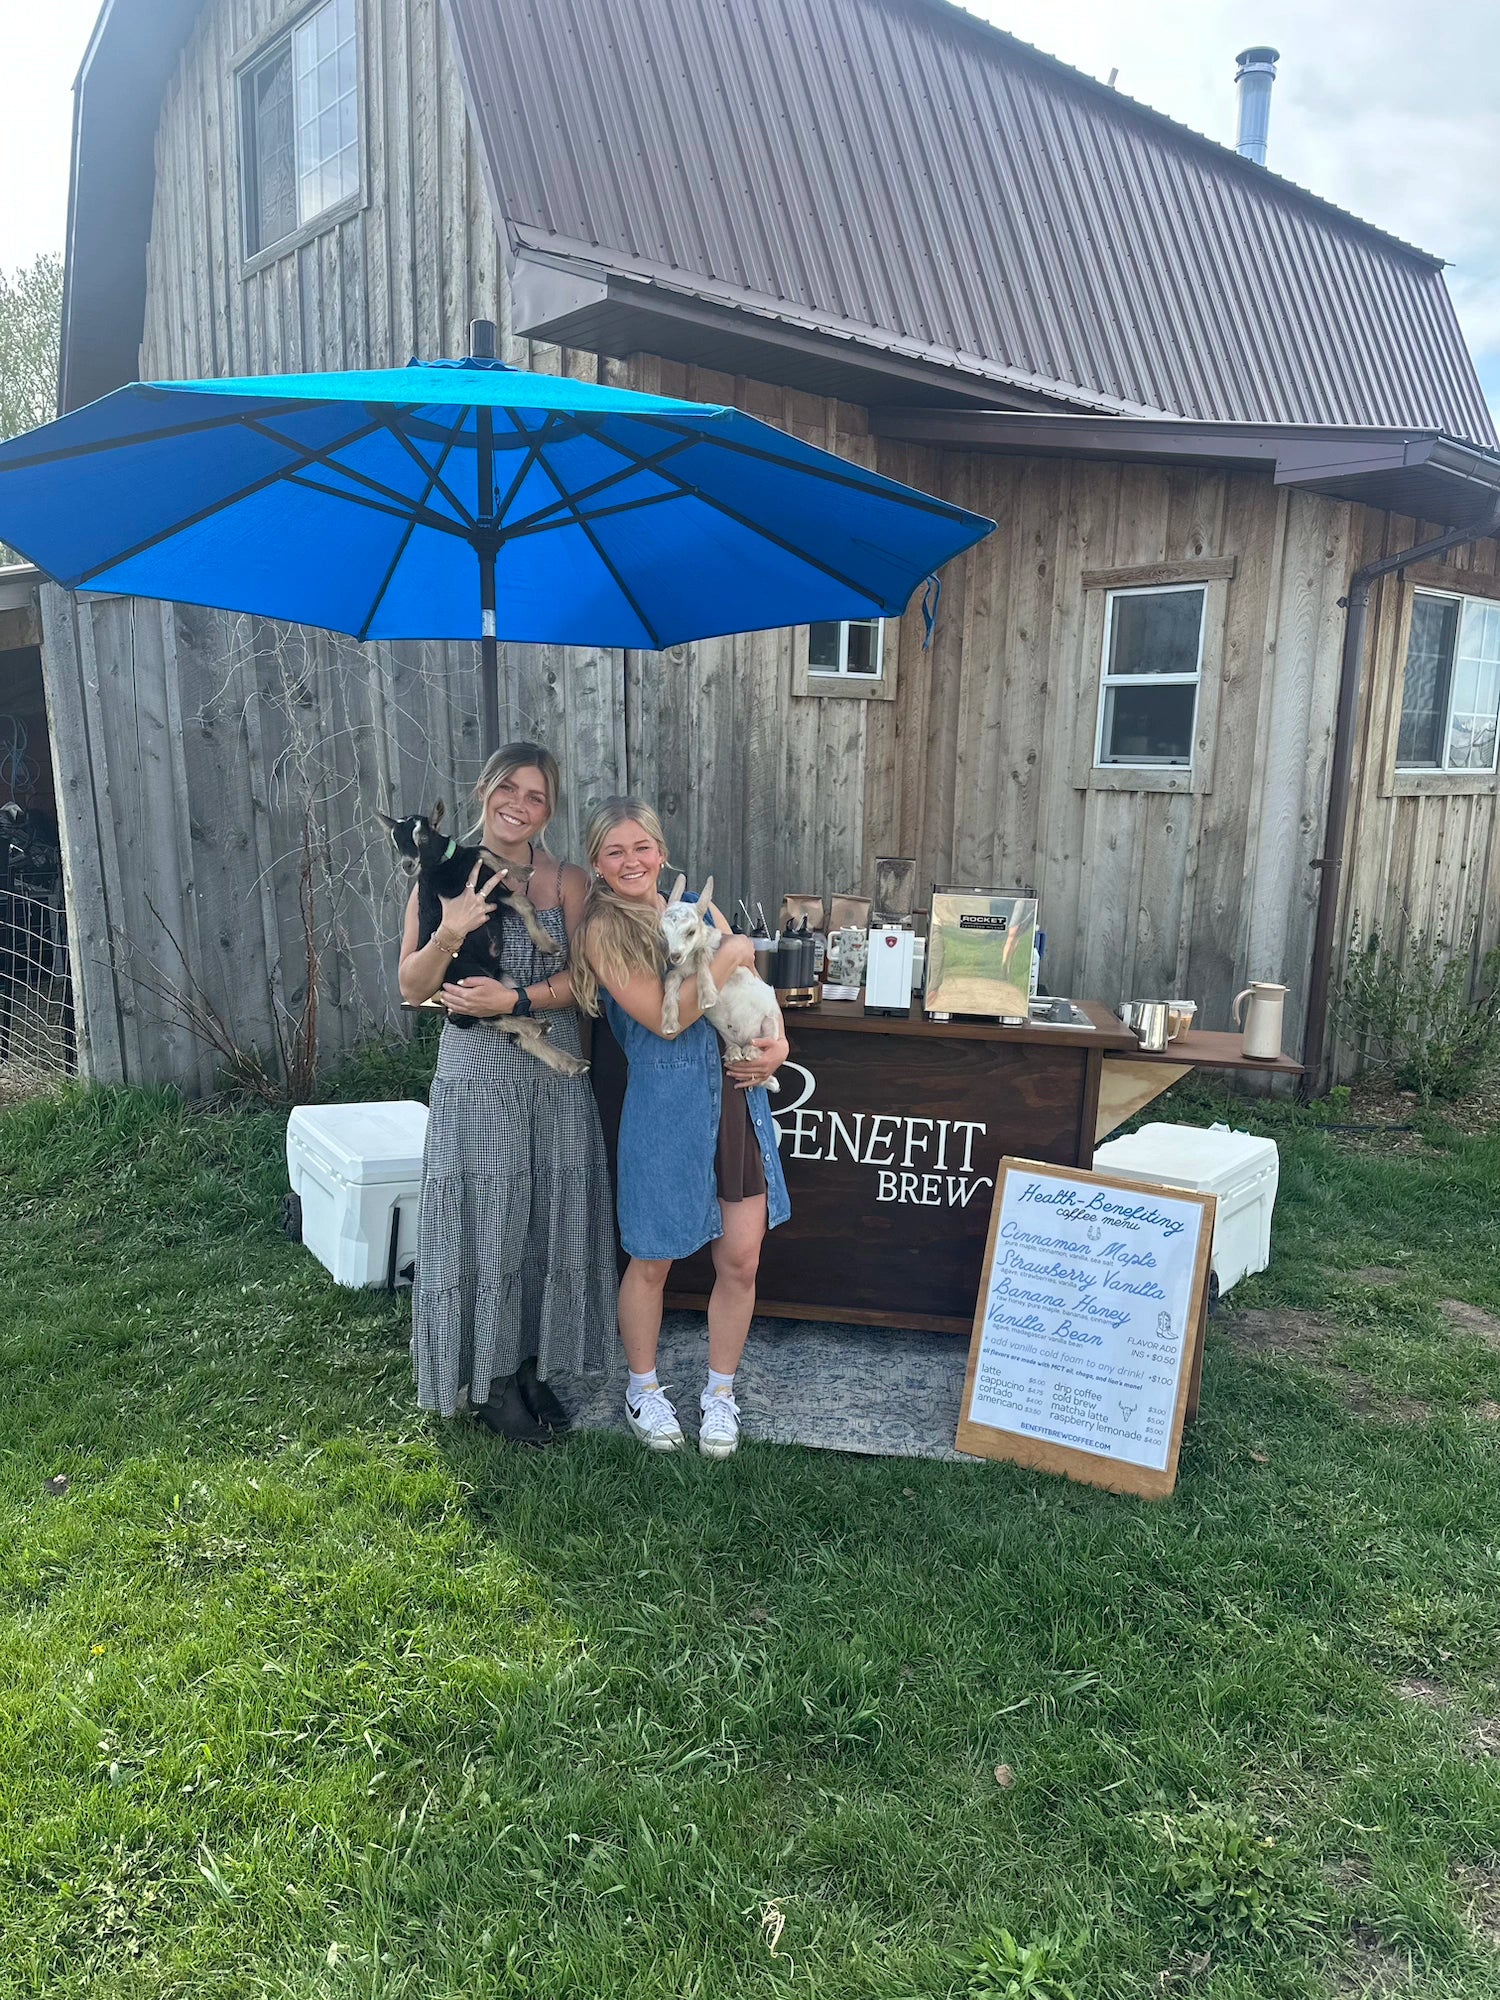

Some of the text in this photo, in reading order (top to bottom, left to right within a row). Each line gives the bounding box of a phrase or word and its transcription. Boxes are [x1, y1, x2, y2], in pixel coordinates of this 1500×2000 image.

[962, 916, 1004, 924] ROCKET
[876, 1170, 993, 1208] BREW
[1018, 1183, 1185, 1237] Health-Benefiting
[1056, 1207, 1141, 1231] coffee menu
[1000, 1221, 1157, 1268] Cinnamon Maple
[996, 1249, 1166, 1300] Strawberry Vanilla
[992, 1277, 1132, 1329] Banana Honey
[987, 1303, 1103, 1346] Vanilla Bean
[1068, 1338, 1083, 1348] bean
[1126, 1336, 1177, 1354] FLAVOR ADD
[1131, 1349, 1145, 1358] INS
[981, 1363, 1002, 1376] latte
[990, 1337, 1009, 1347] add
[1010, 1341, 1038, 1354] vanilla
[1039, 1349, 1059, 1359] cold
[1060, 1352, 1084, 1365] foam
[1086, 1359, 1096, 1368] to
[1098, 1363, 1115, 1375] any
[1117, 1366, 1145, 1380] drink!
[990, 1348, 1010, 1359] flavors
[1021, 1357, 1036, 1365] made
[1050, 1363, 1065, 1373] MCT
[979, 1384, 1013, 1398] cortado
[980, 1374, 1025, 1392] cappucino
[1054, 1382, 1072, 1395] drip
[1073, 1388, 1102, 1401] coffee
[977, 1393, 1023, 1411] americano
[1051, 1402, 1086, 1417] matcha
[1087, 1410, 1109, 1423] latte
[1052, 1393, 1072, 1404] cold
[1073, 1396, 1097, 1410] brew
[1020, 1421, 1111, 1451] BENEFITBREWCOFFEE.COM
[1049, 1412, 1095, 1432] raspberry
[1096, 1422, 1142, 1441] lemonade
